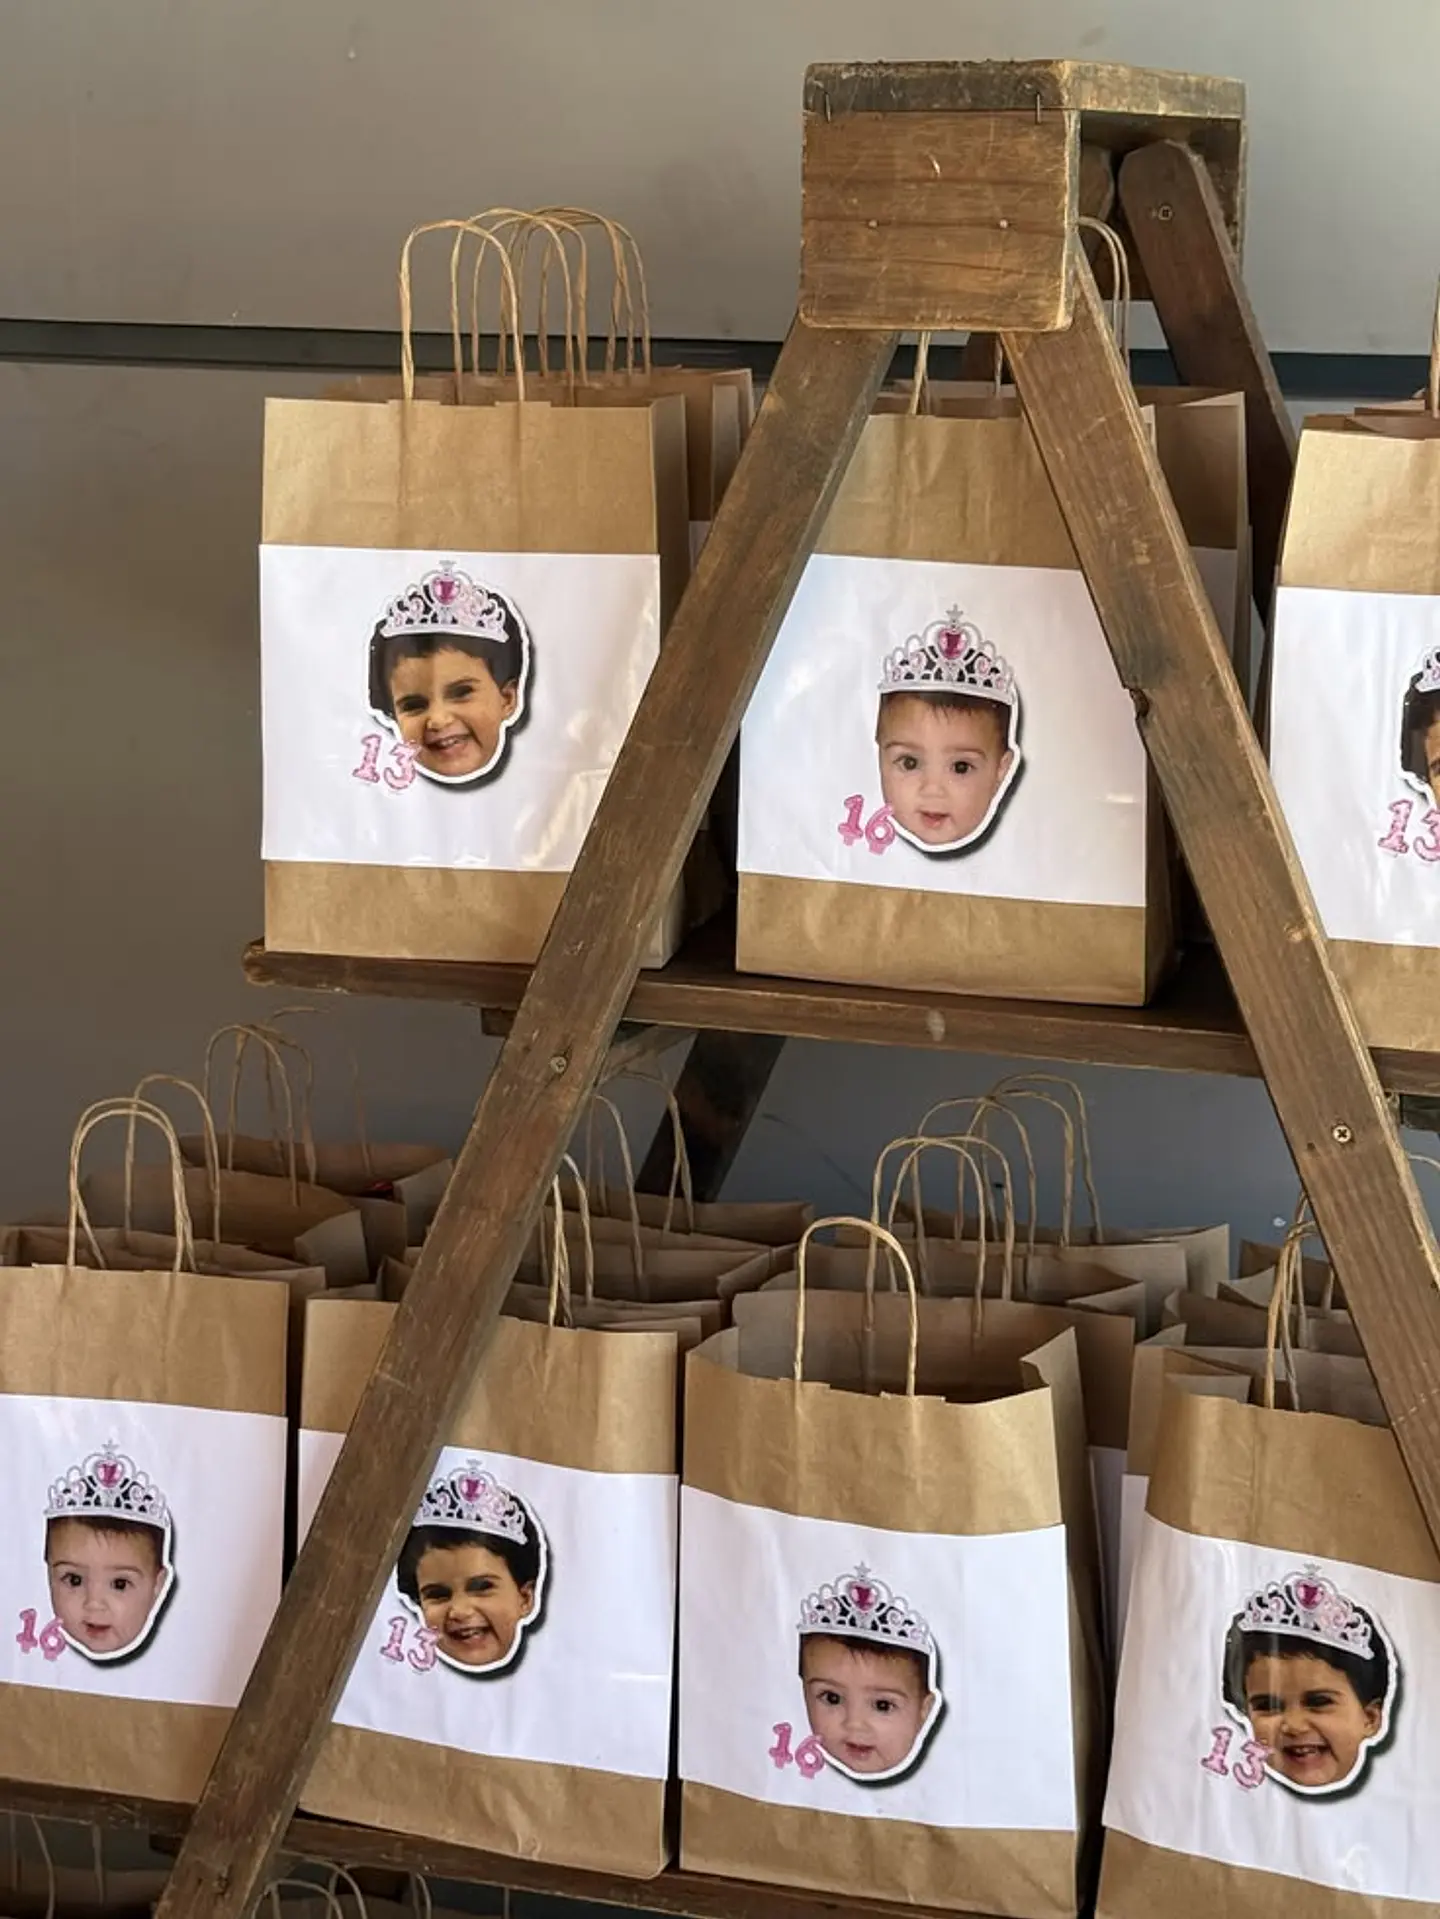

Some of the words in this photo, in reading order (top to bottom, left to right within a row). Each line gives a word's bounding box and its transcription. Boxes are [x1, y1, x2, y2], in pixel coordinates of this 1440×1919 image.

[352, 734, 420, 791] 13
[838, 794, 896, 855] 16
[16, 1608, 66, 1661] 16
[380, 1616, 439, 1672] 13
[769, 1722, 826, 1779] 16
[1200, 1726, 1271, 1789] 13
